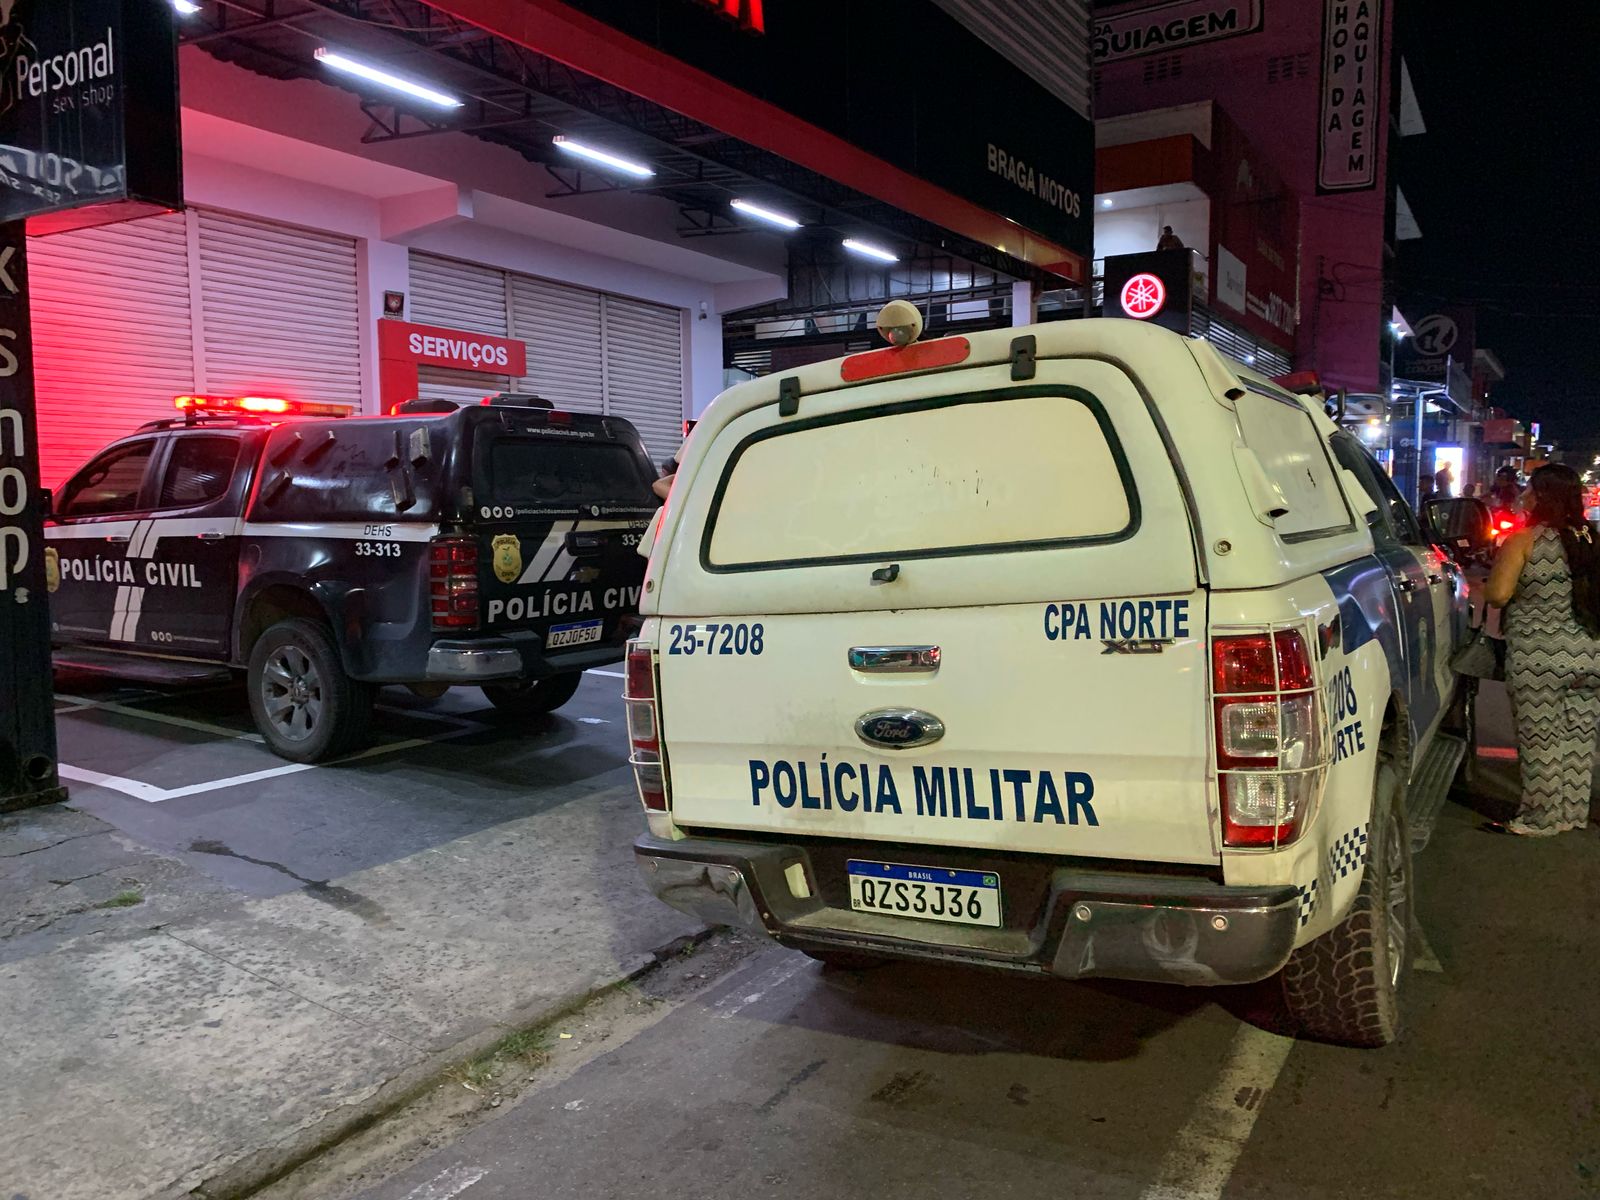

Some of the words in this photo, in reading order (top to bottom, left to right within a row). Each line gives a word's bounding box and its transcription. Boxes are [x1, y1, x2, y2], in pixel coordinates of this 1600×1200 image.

[1333, 0, 1348, 73] HOP
[17, 27, 113, 99] Personal
[82, 83, 114, 107] shop
[987, 143, 1036, 196] BRAGA
[1039, 172, 1081, 218] MOTOS
[409, 333, 508, 368] SERVIÇOS
[364, 525, 392, 537] DEHS
[355, 542, 401, 557] 33-313
[60, 554, 135, 583] POLÍCIA
[145, 562, 202, 587] CIVIL
[487, 588, 594, 623] POLÍCIA
[1044, 603, 1091, 641] CPA
[1100, 600, 1189, 639] NORTE
[668, 623, 764, 655] 25-7208
[874, 720, 911, 738] Ford
[748, 752, 903, 815] POLÍCIA
[912, 765, 1100, 827] MILITAR
[908, 872, 932, 881] BRASIL
[861, 879, 982, 919] QZS3J36
